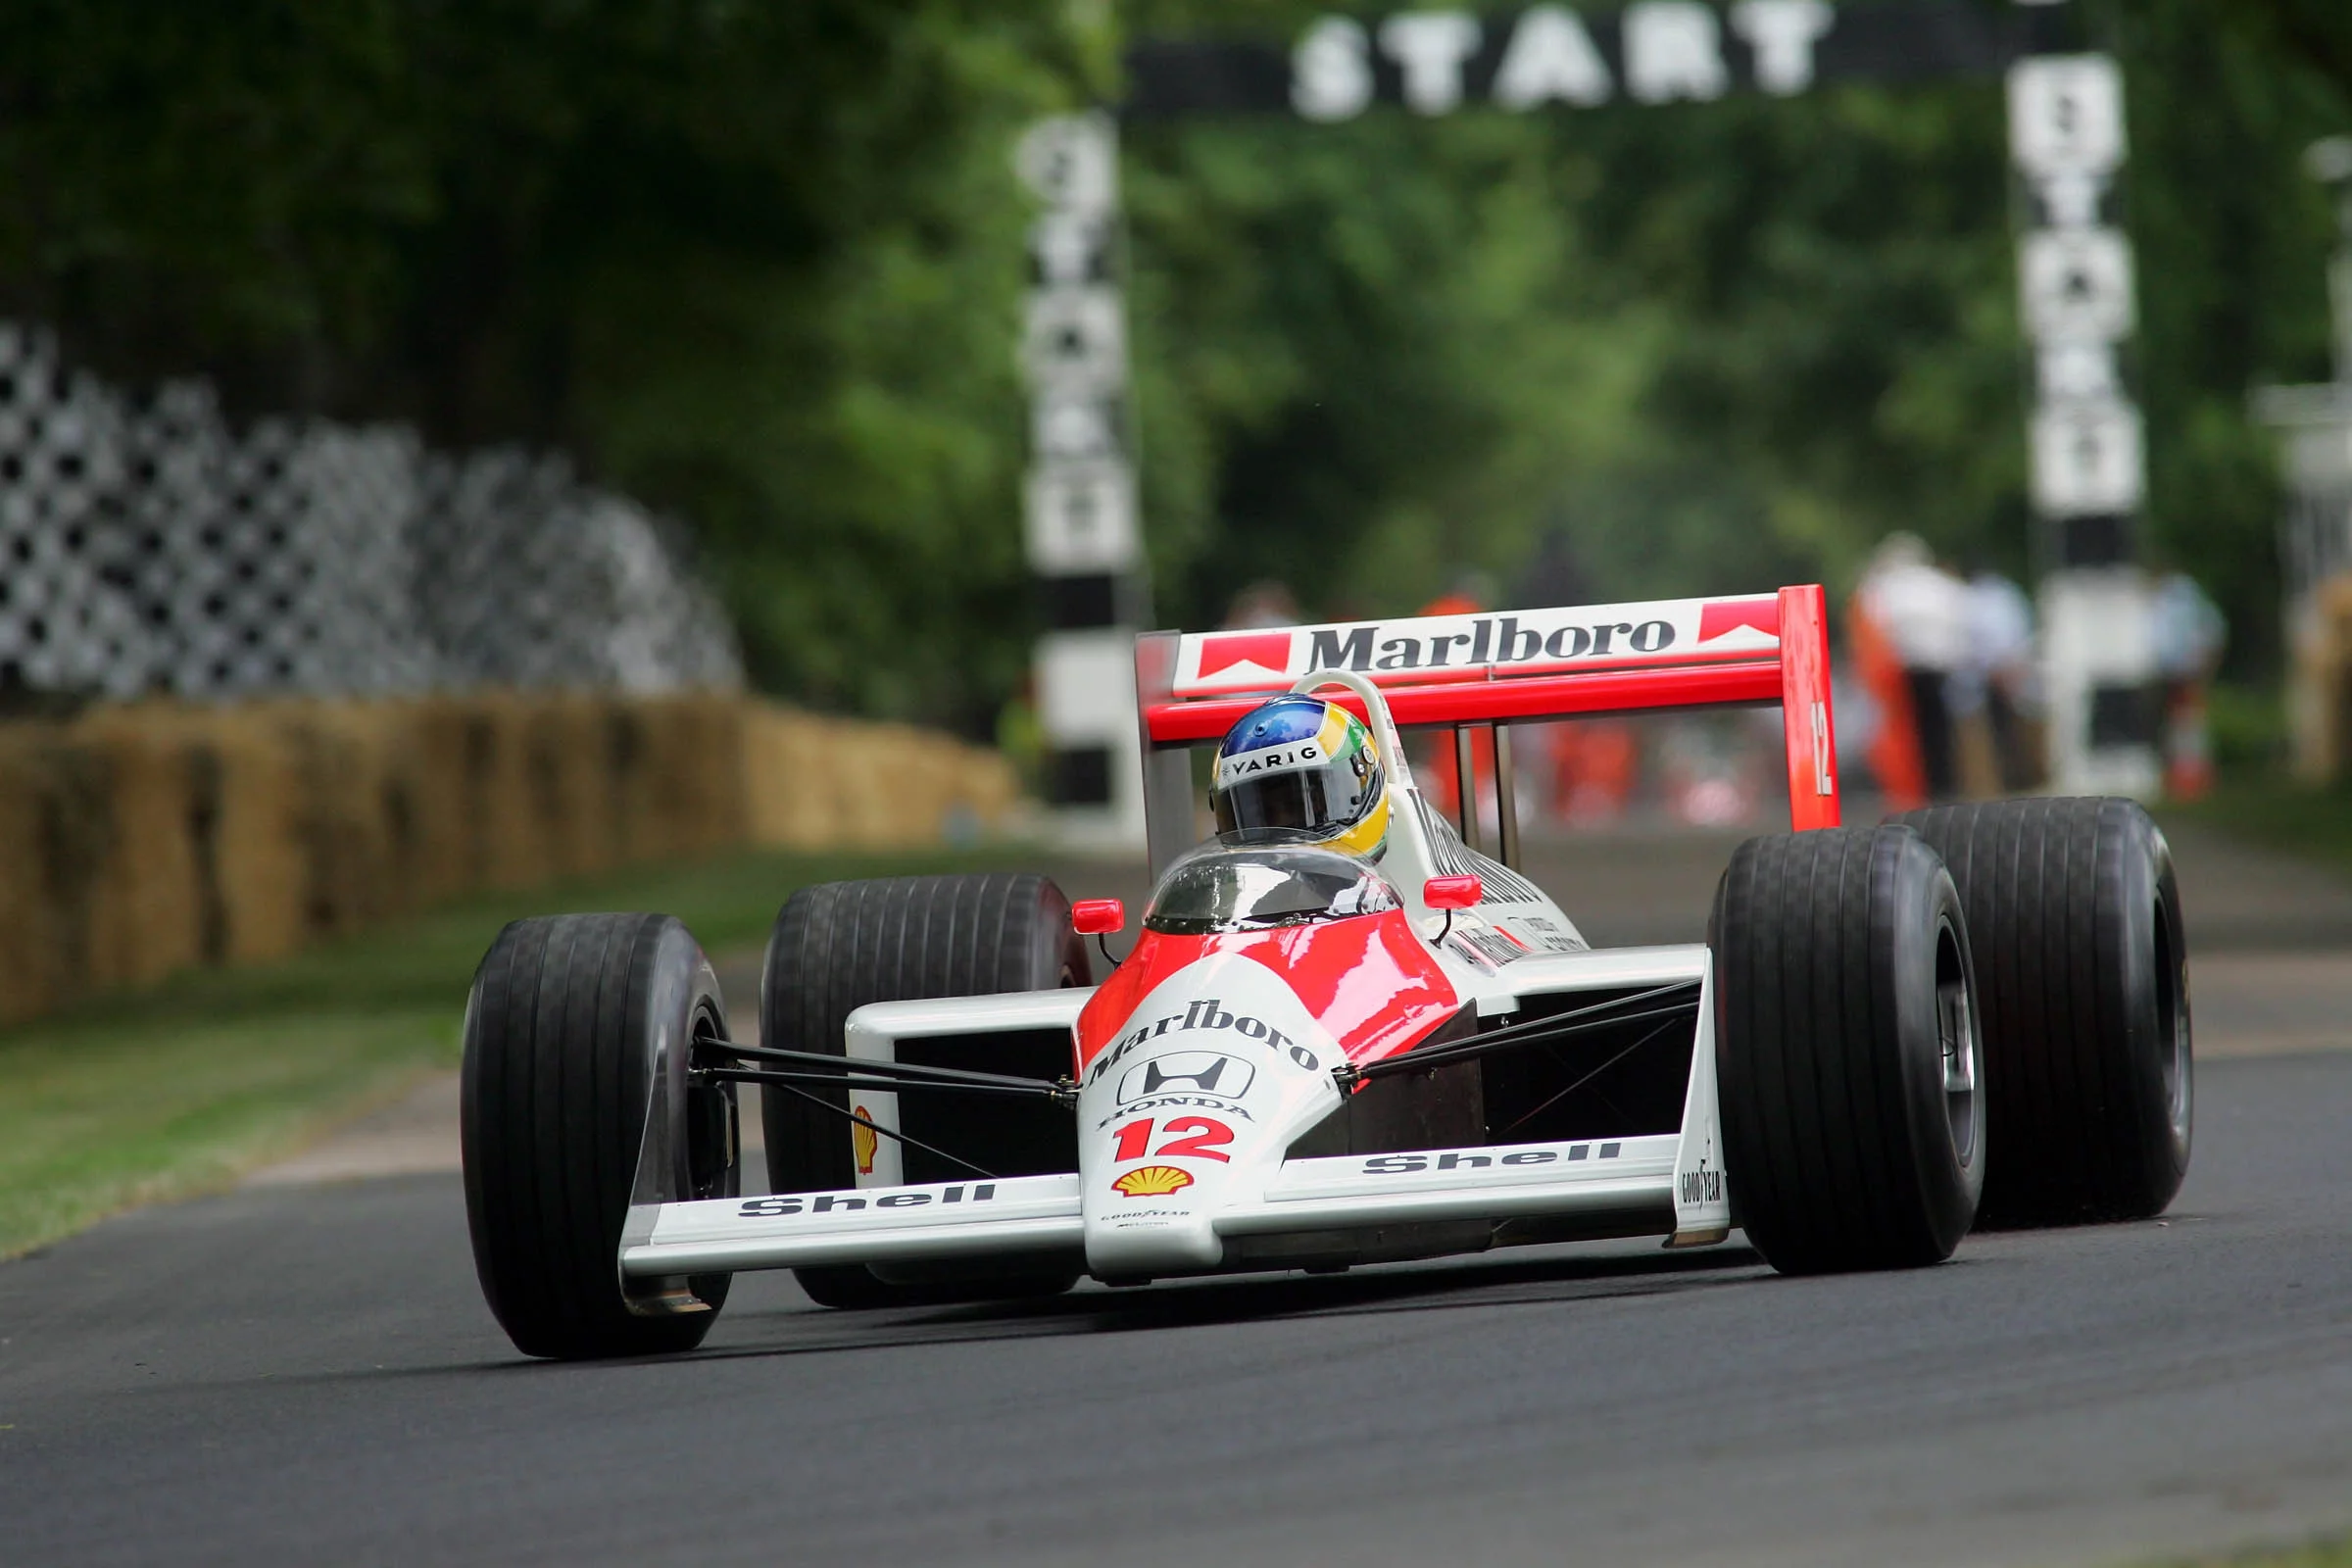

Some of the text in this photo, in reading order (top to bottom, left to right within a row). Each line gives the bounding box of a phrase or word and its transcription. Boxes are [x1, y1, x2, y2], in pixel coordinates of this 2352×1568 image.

[1291, 0, 1833, 122] START
[1303, 617, 1676, 676] Marlboro
[1232, 747, 1317, 775] VARIG
[1810, 699, 1834, 797] 12
[1086, 1000, 1319, 1090] Marlboro
[1096, 1097, 1256, 1133] HONDA
[1112, 1115, 1235, 1163] 12
[1362, 1142, 1622, 1175] Shell
[738, 1184, 996, 1218] Shell
